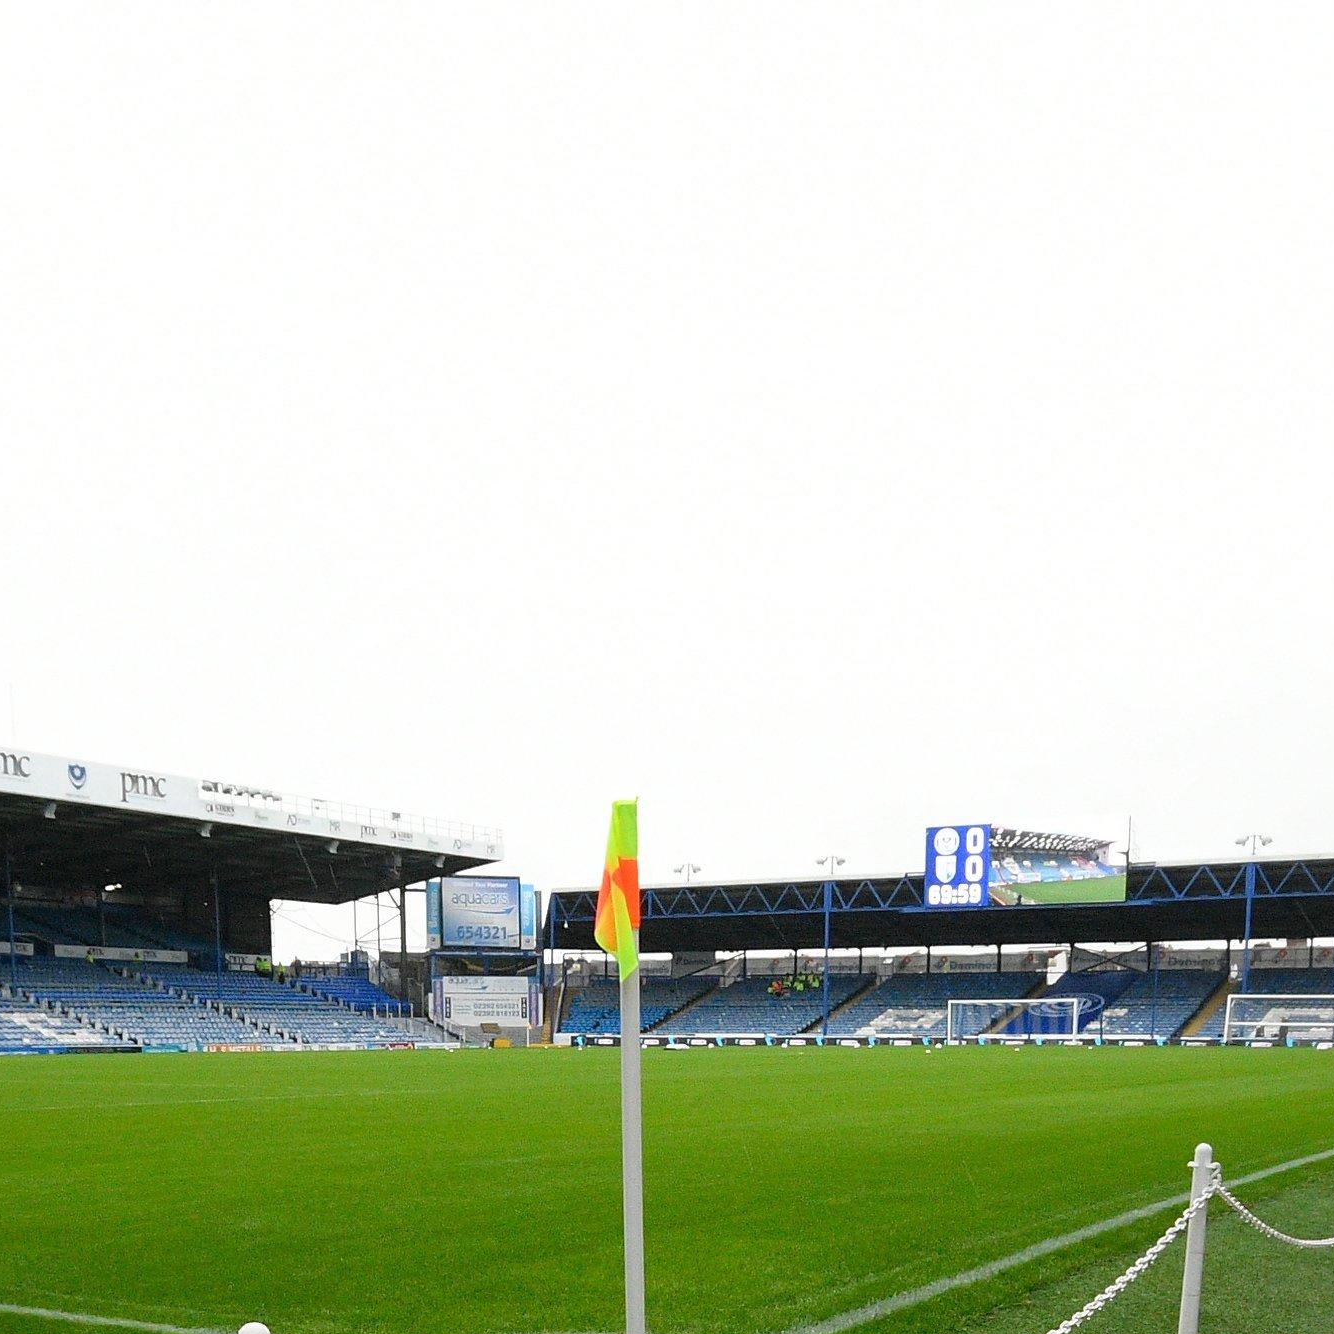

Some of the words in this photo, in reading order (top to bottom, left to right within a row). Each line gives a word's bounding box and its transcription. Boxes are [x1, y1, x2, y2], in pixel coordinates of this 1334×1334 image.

[120, 772, 166, 802] pmc
[360, 825, 378, 838] pmc
[966, 827, 984, 854] 0
[965, 855, 983, 882] 0
[451, 892, 508, 907] aquacars
[457, 926, 507, 940] 654321
